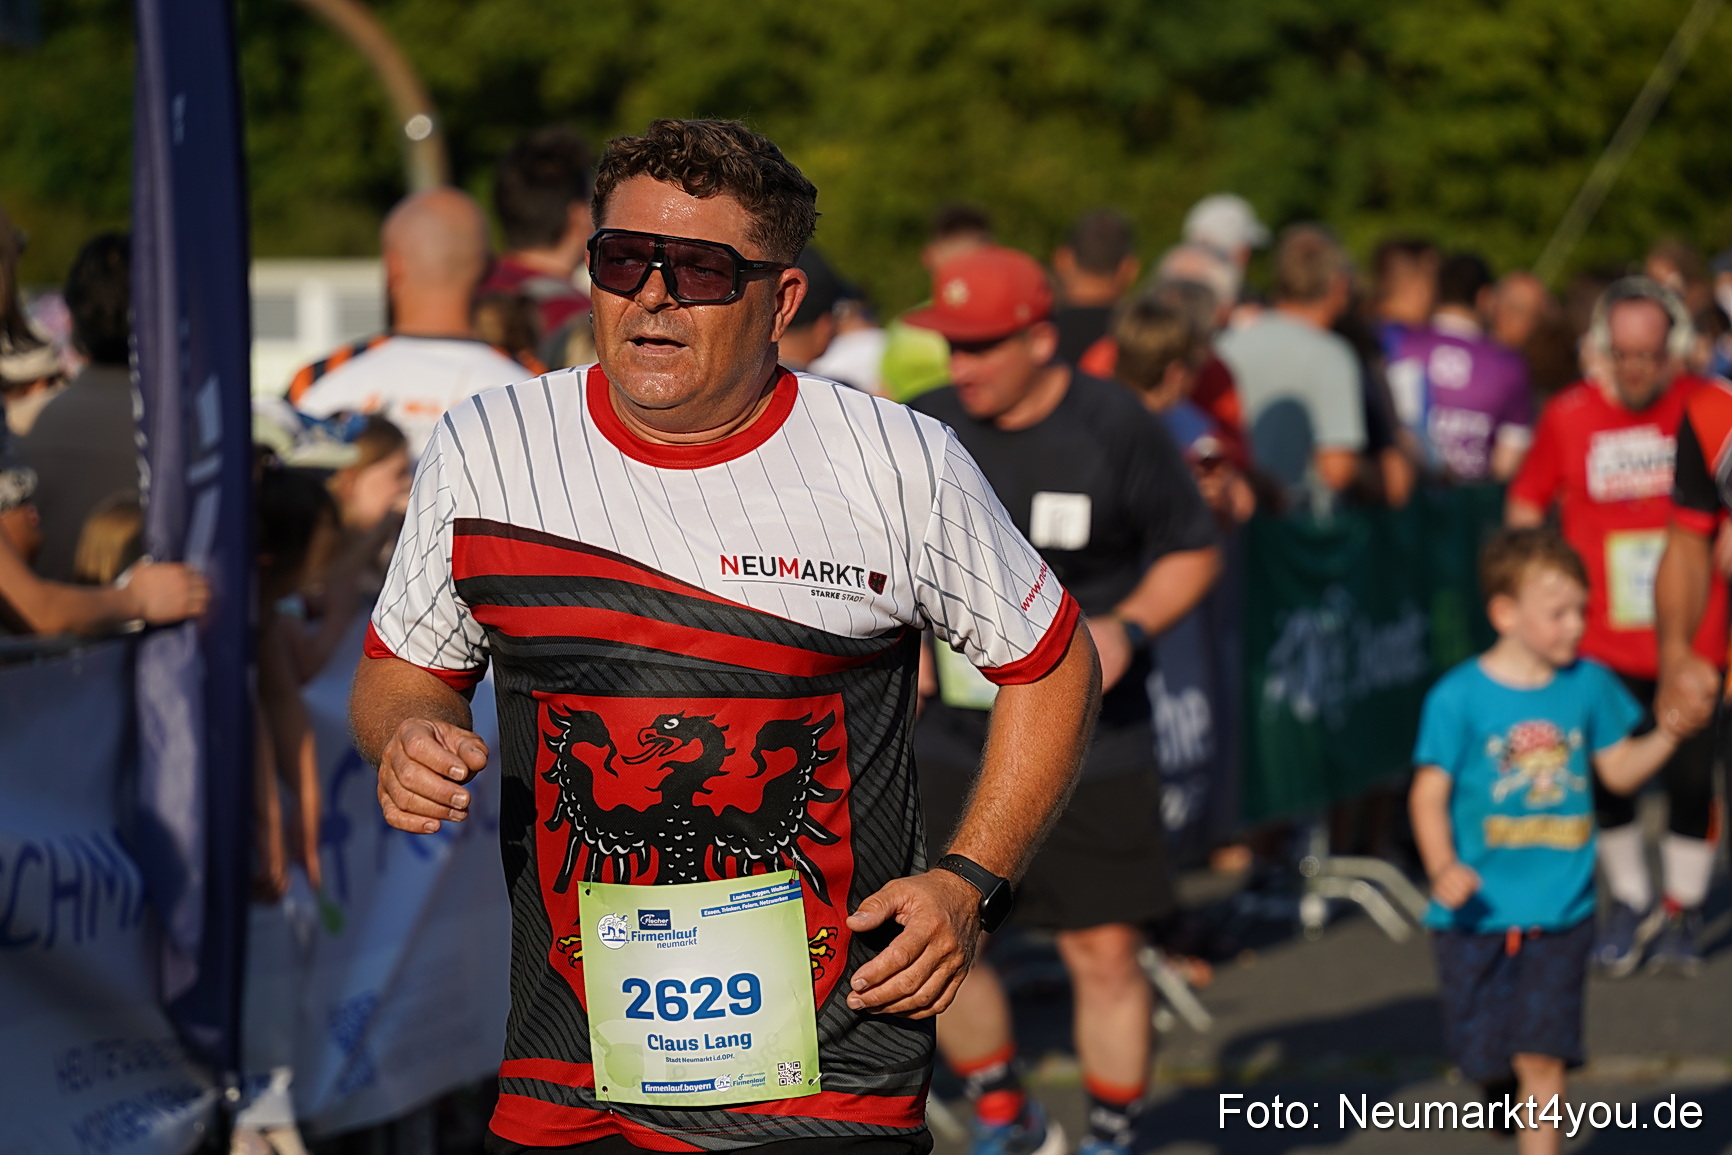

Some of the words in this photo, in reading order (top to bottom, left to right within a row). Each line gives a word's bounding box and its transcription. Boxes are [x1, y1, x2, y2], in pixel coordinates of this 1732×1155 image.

[720, 554, 865, 588] NEUMARKT
[811, 589, 841, 600] STARKE
[841, 594, 865, 603] STADT
[751, 889, 771, 898] Joggen,
[770, 884, 790, 893] Walken
[721, 905, 742, 913] Trinken,
[742, 902, 759, 910] Feiern,
[759, 896, 789, 906] Netzwerken
[640, 914, 669, 926] Fischer
[631, 926, 698, 942] Firmenlauf
[656, 938, 698, 949] neumarkt
[622, 973, 762, 1022] 2629
[647, 1033, 700, 1052] Claus
[704, 1032, 752, 1050] Lang
[682, 1055, 713, 1063] Neumarkt
[645, 1083, 712, 1093] firmenlauf.bayern
[732, 1076, 766, 1087] Firmenlauf
